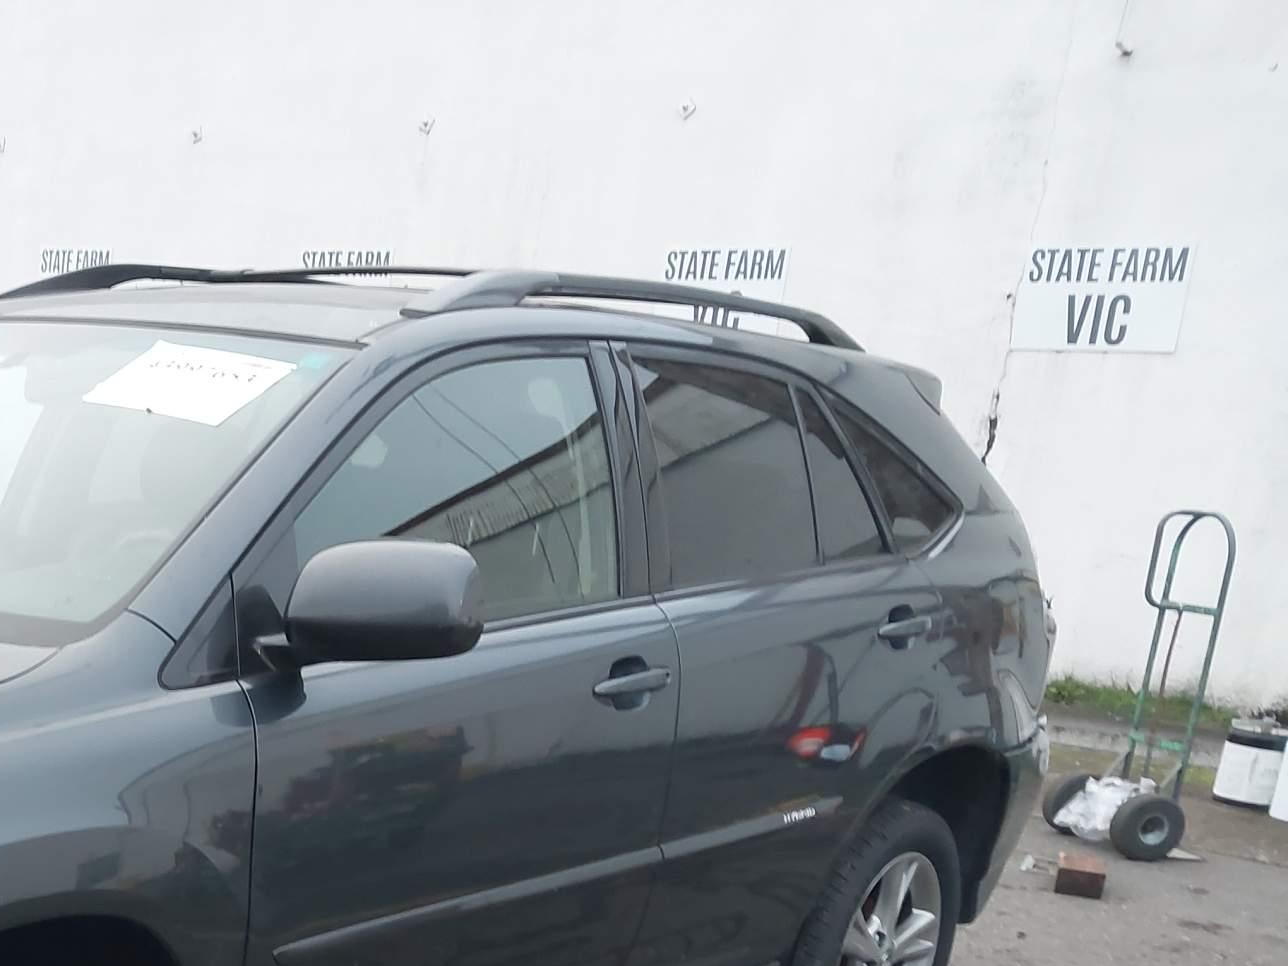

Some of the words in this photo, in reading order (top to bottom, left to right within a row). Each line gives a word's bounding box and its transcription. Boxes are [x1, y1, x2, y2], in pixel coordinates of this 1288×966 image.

[40, 248, 73, 273] STATE
[665, 250, 721, 280] STATE
[724, 249, 787, 280] FARM
[1029, 248, 1104, 282] STATE
[1108, 247, 1189, 282] FARM
[1066, 294, 1131, 346] VIC
